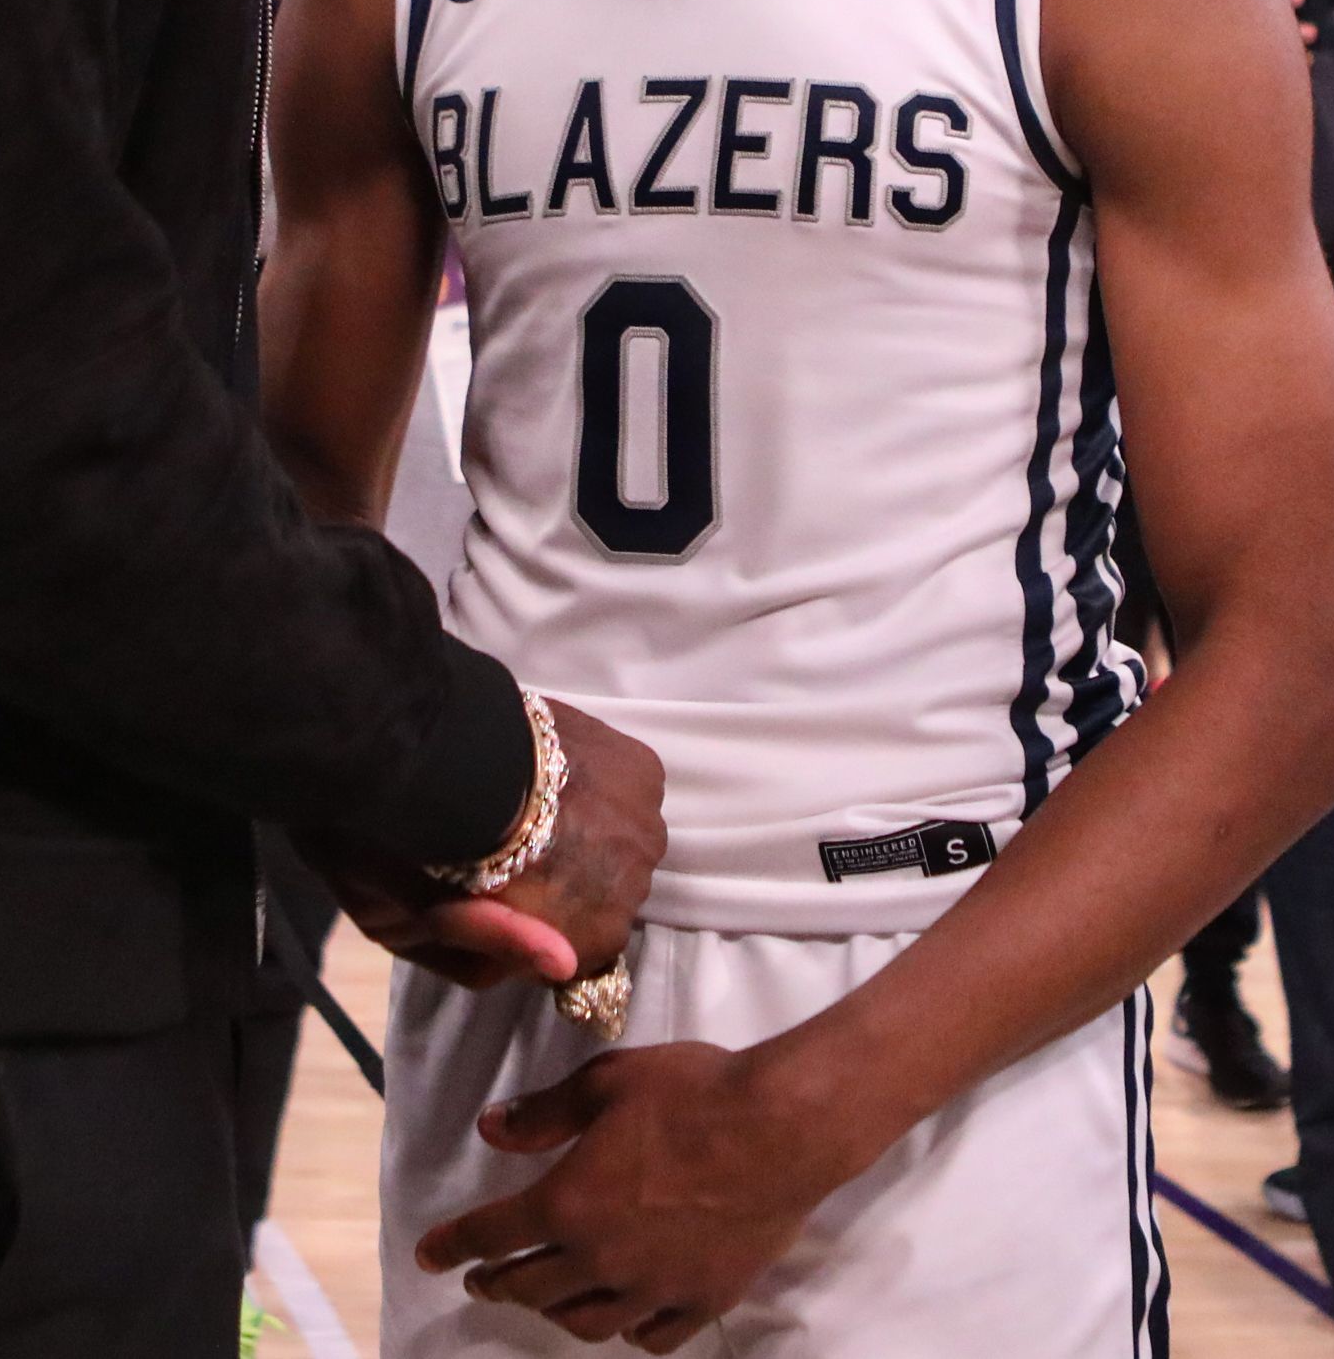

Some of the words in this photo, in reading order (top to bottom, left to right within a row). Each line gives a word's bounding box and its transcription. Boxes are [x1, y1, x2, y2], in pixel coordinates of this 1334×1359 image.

[432, 75, 972, 233] BLAZERS
[570, 274, 723, 565] 0
[832, 837, 917, 860] ENGINEERED
[946, 838, 969, 866] S
